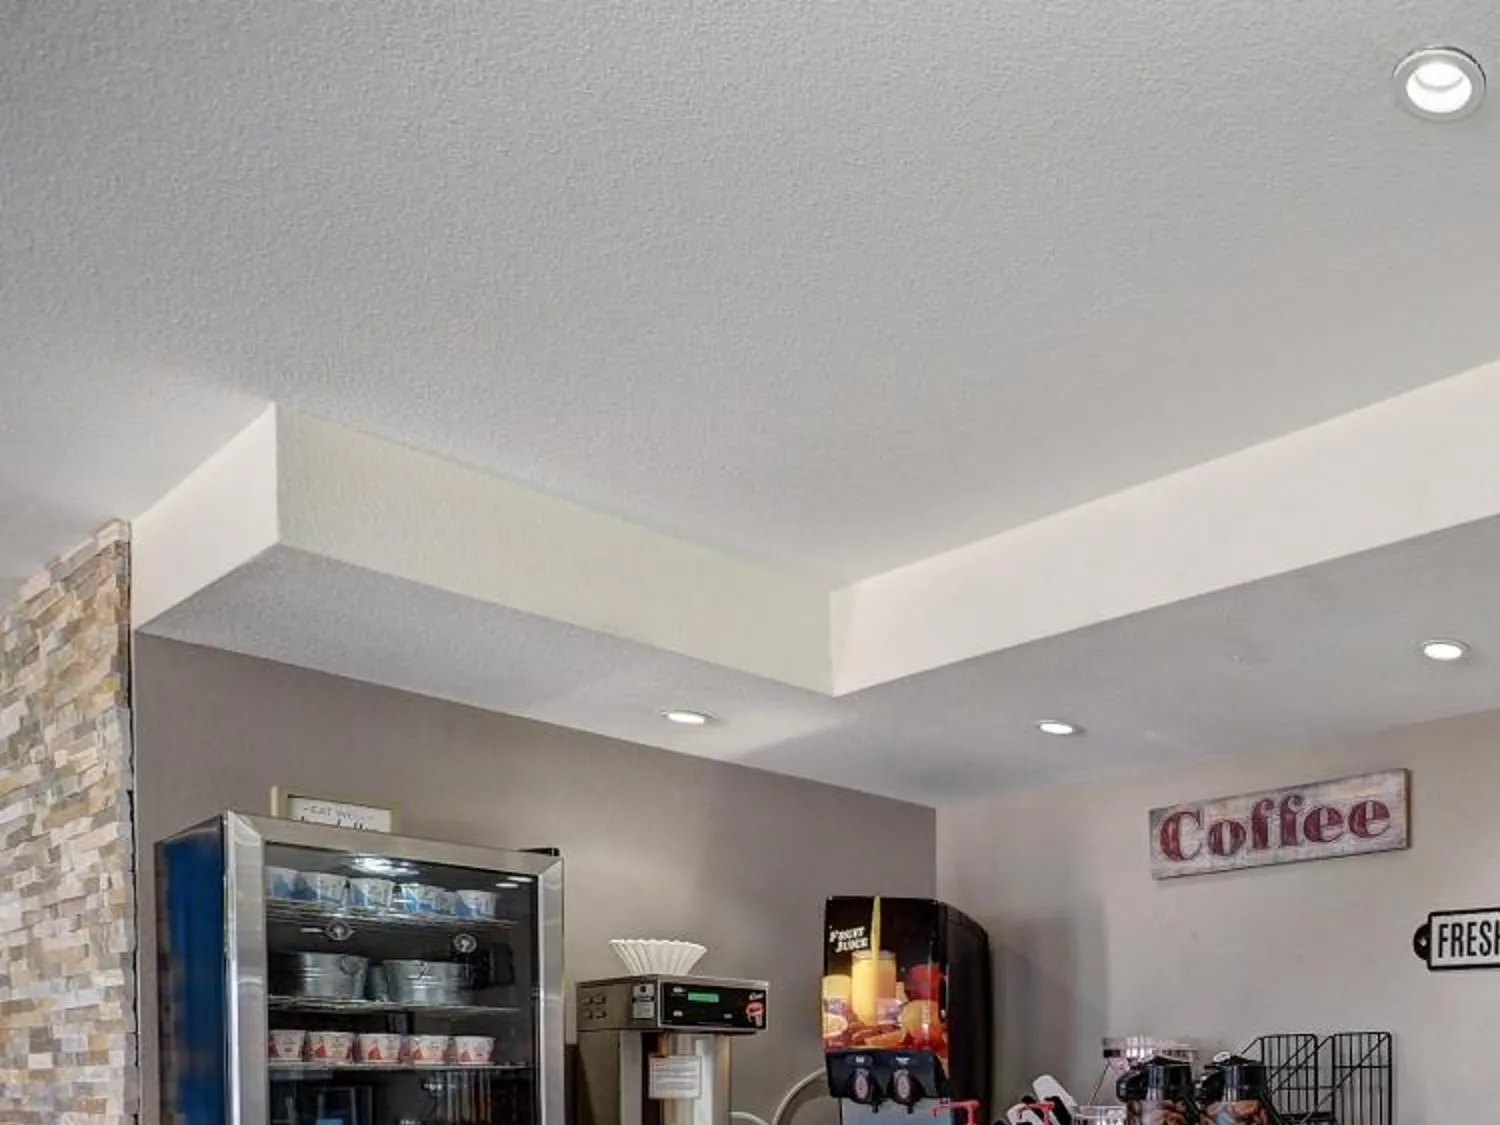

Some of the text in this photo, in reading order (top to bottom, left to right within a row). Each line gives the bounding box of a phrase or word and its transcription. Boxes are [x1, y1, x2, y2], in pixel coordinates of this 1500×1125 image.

[1160, 795, 1391, 861] Coffee
[829, 926, 865, 943] FRUIT
[835, 937, 869, 953] JUICE
